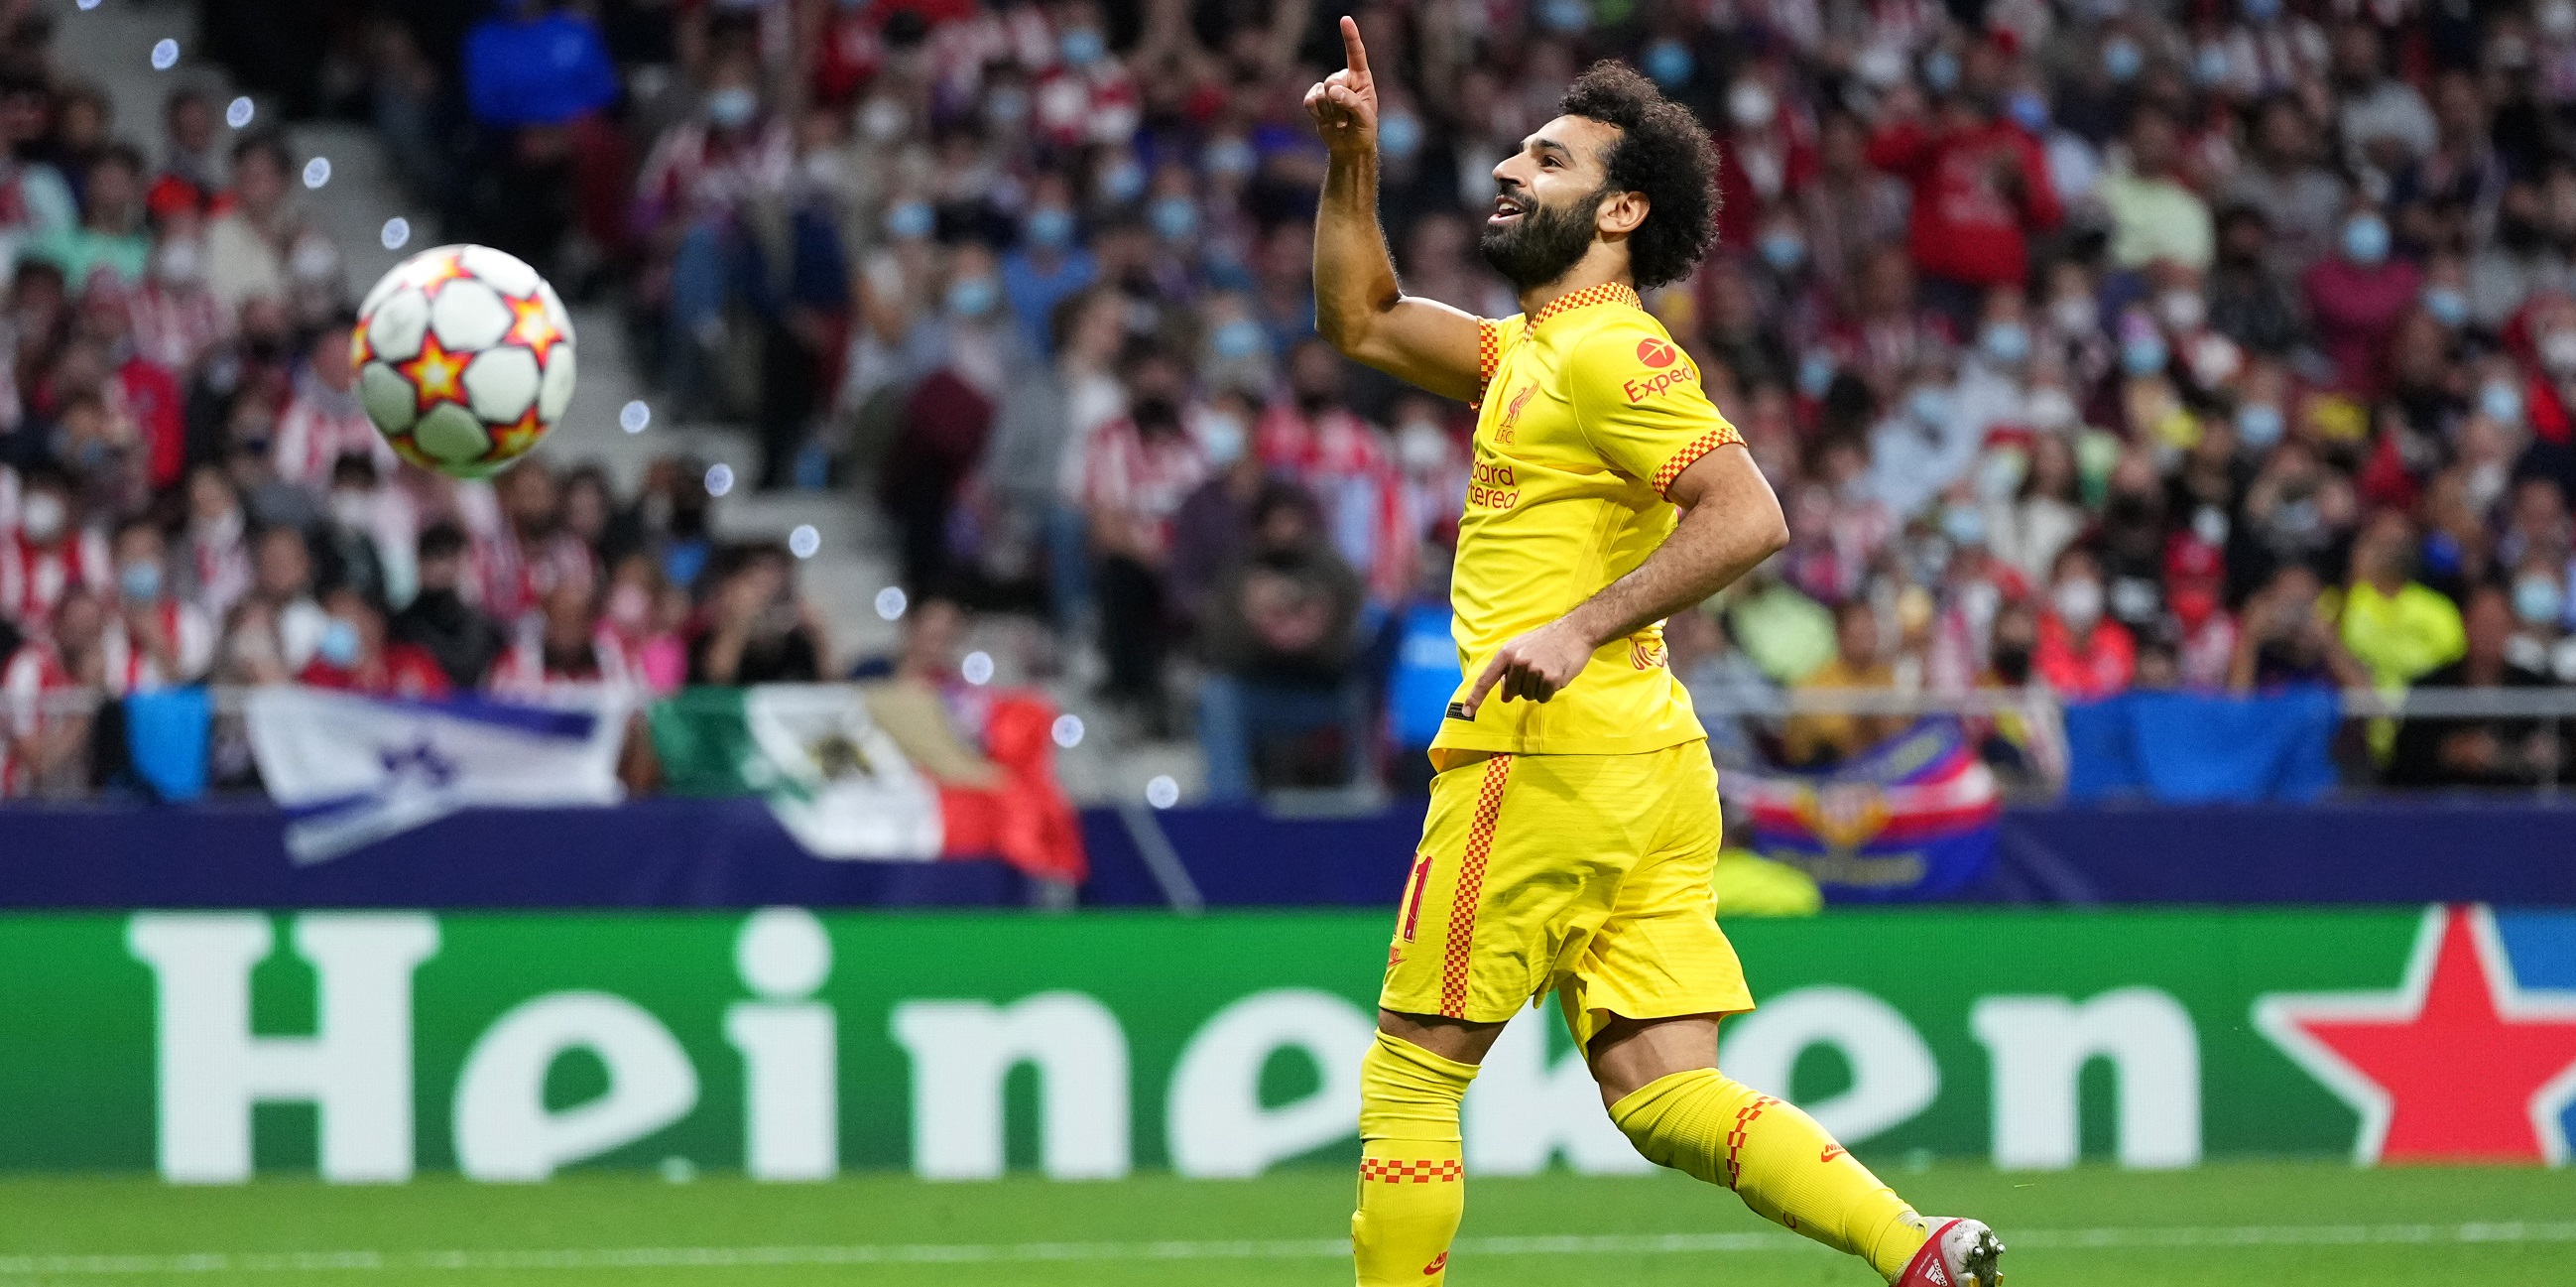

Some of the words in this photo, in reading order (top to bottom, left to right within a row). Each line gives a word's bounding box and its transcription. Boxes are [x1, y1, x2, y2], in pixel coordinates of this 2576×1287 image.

[1623, 360, 1697, 404] Exped
[1472, 457, 1516, 487] dard
[1467, 479, 1521, 510] tered
[126, 905, 2202, 1183] Heineken
